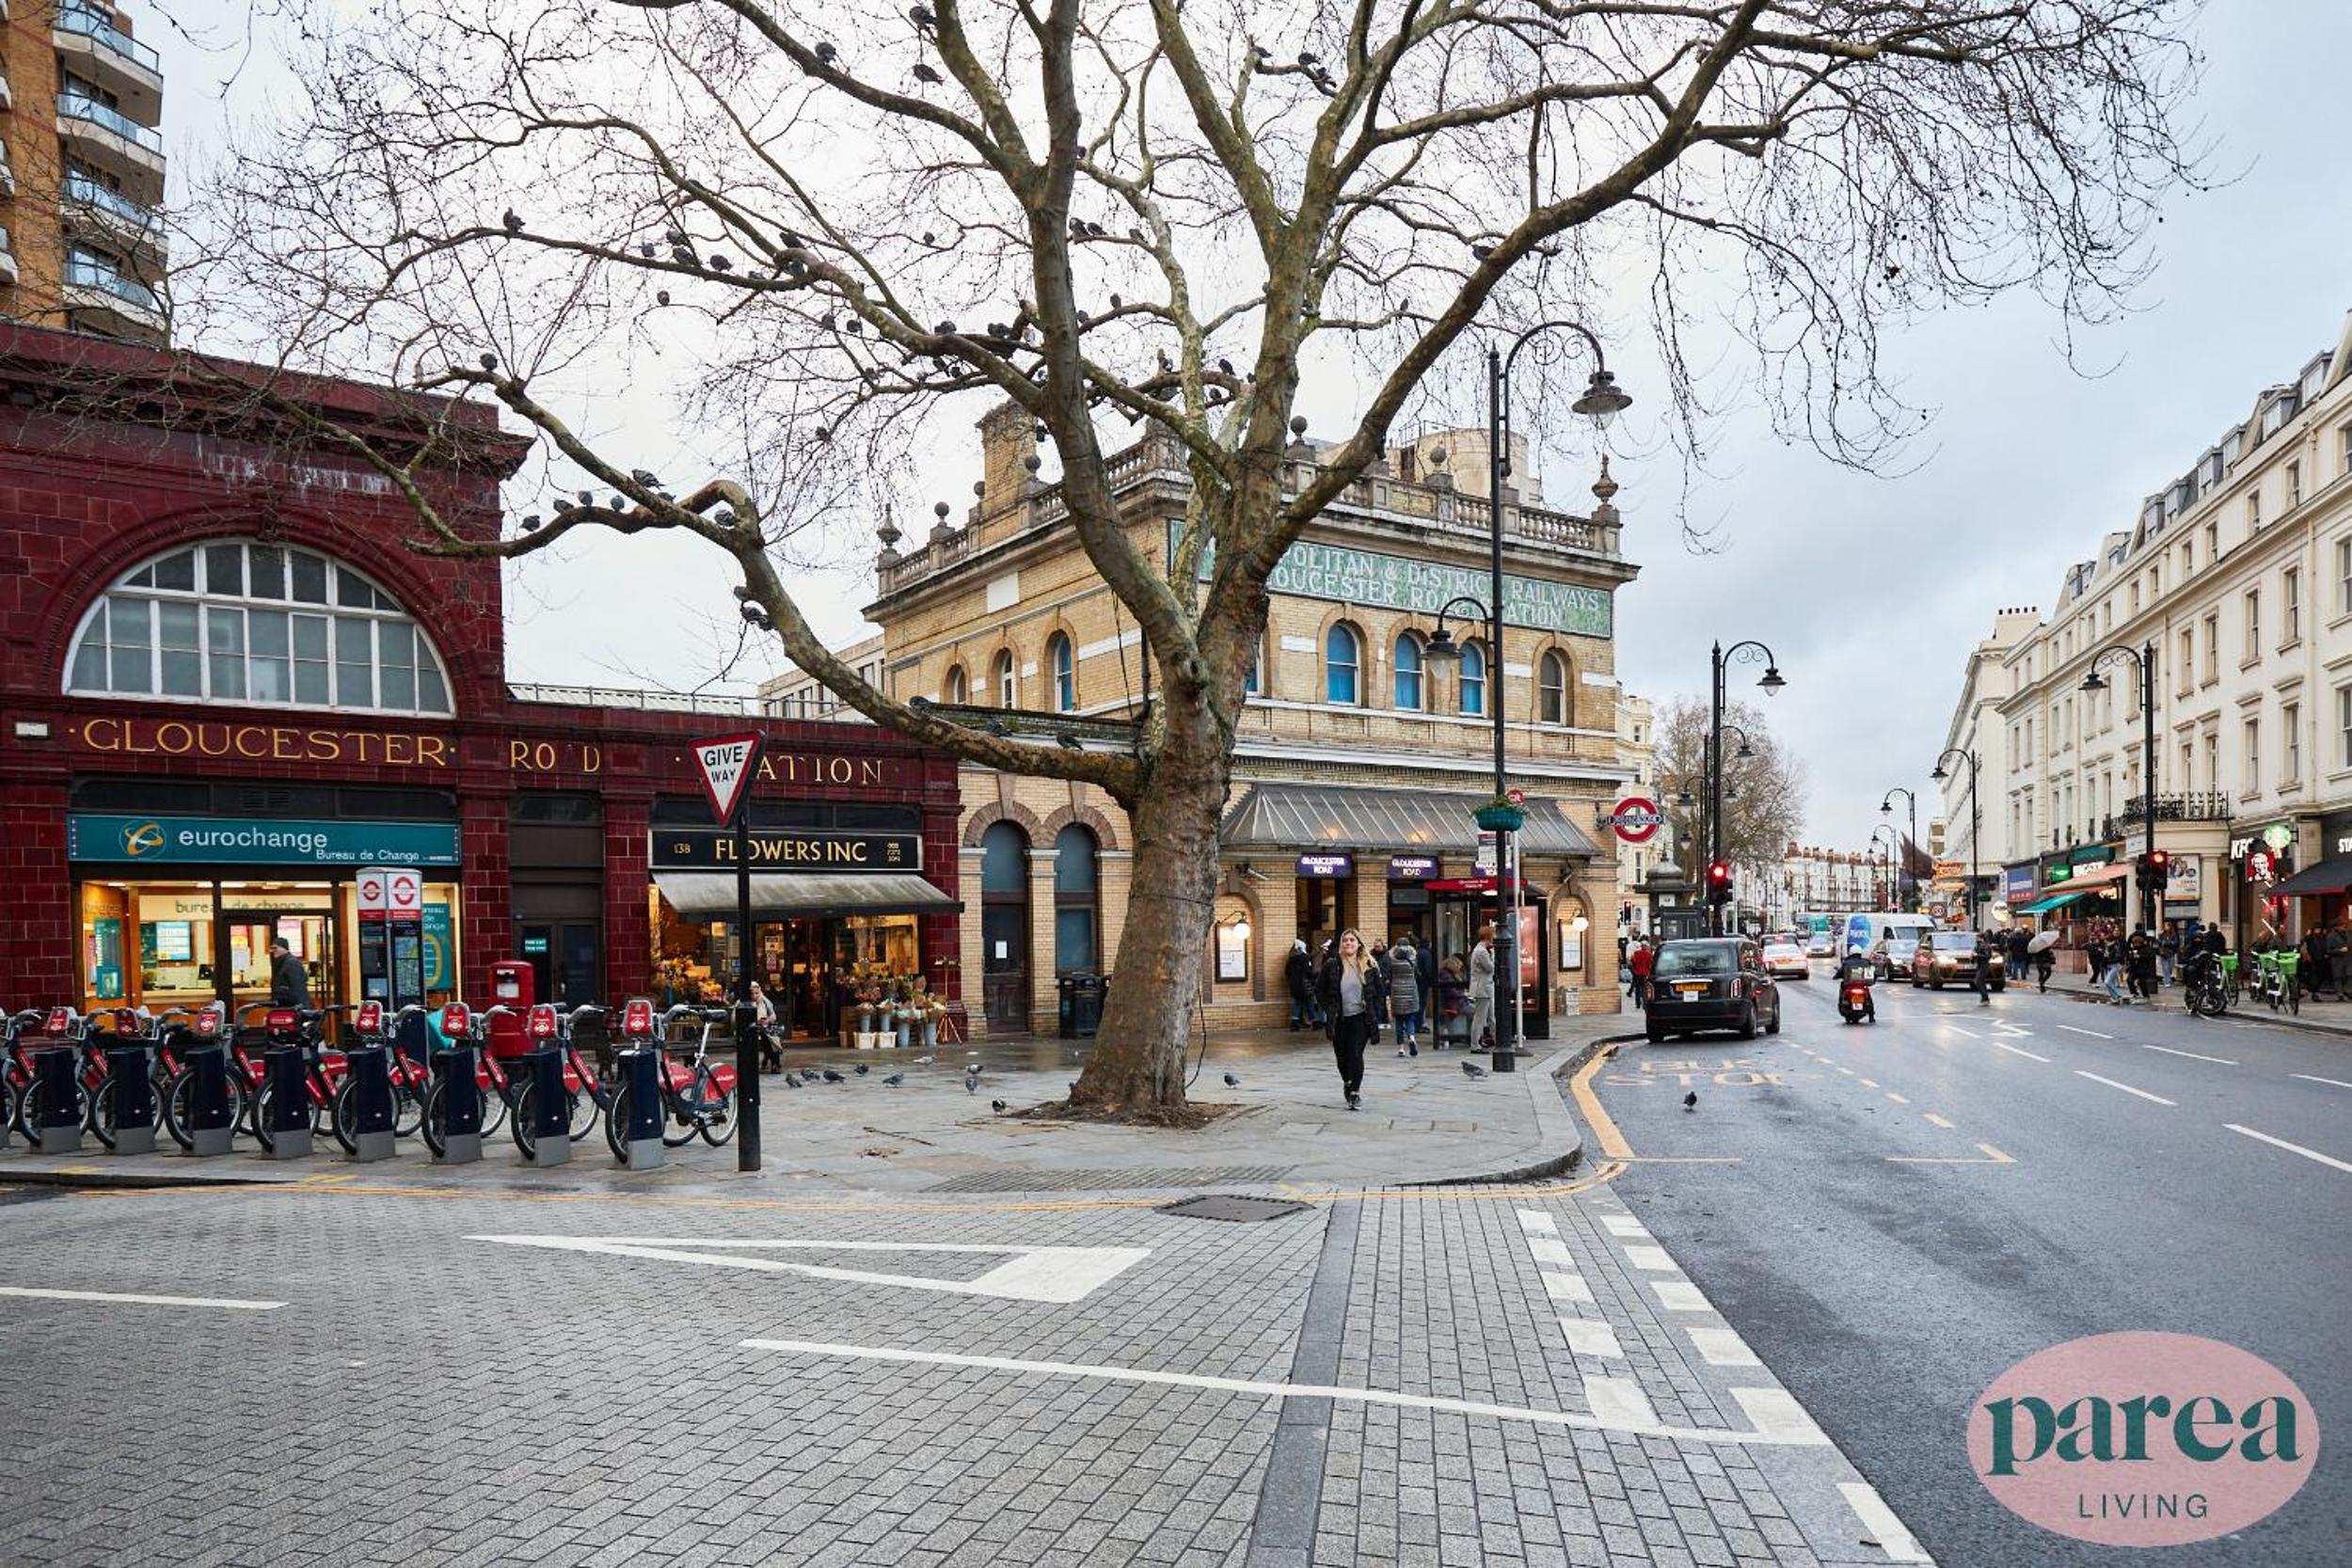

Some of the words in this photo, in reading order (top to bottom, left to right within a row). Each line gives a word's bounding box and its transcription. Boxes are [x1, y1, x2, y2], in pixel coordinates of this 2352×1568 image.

[1269, 567, 1396, 604] OUCESTER
[1385, 562, 1397, 581] &
[1407, 563, 1492, 593] DISTRIC
[1512, 580, 1599, 610] RAILWAYS
[83, 718, 446, 767] GLOUCESTER
[509, 739, 601, 773] ROD
[704, 745, 743, 767] GIVE
[710, 768, 737, 784] WAY
[178, 827, 327, 853] eurochange
[315, 848, 356, 861] Bureau
[359, 848, 374, 861] de
[377, 848, 420, 863] Change
[826, 841, 868, 863] INC
[1604, 1071, 1784, 1085] STOP
